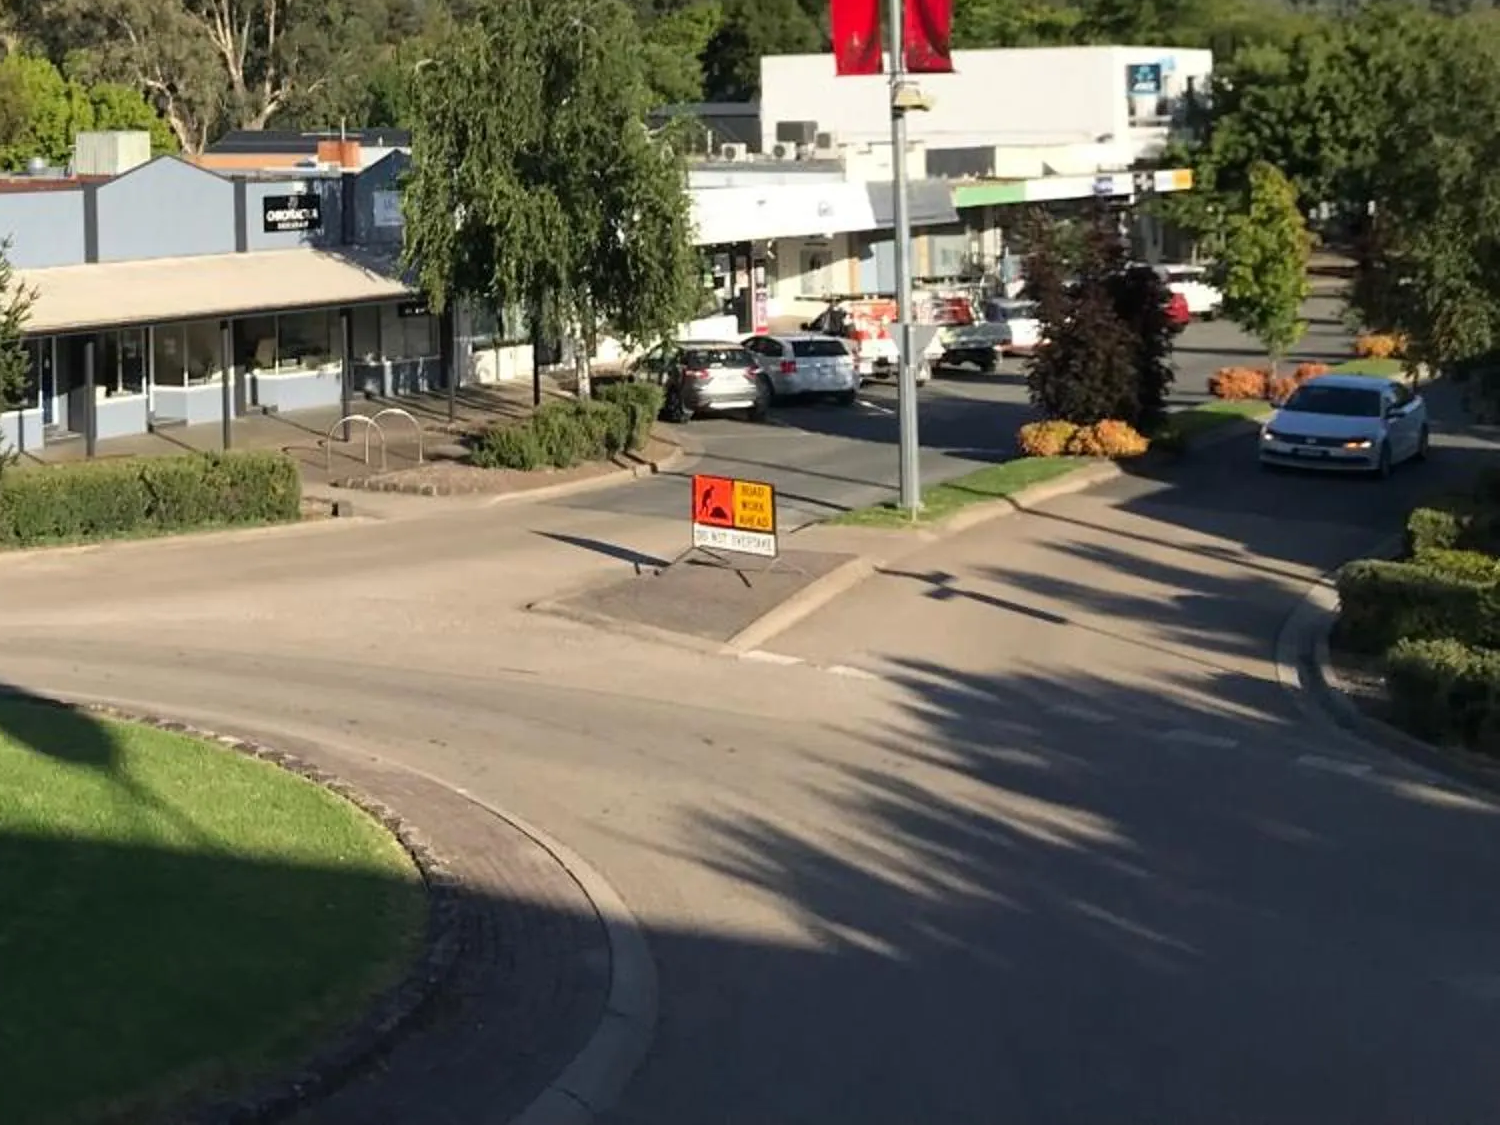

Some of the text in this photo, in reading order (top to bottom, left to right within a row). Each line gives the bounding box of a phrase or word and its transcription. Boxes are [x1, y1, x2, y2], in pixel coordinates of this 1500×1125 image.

[742, 485, 765, 497] ROAD
[741, 501, 764, 512] WORK
[739, 515, 769, 528] AHEAD
